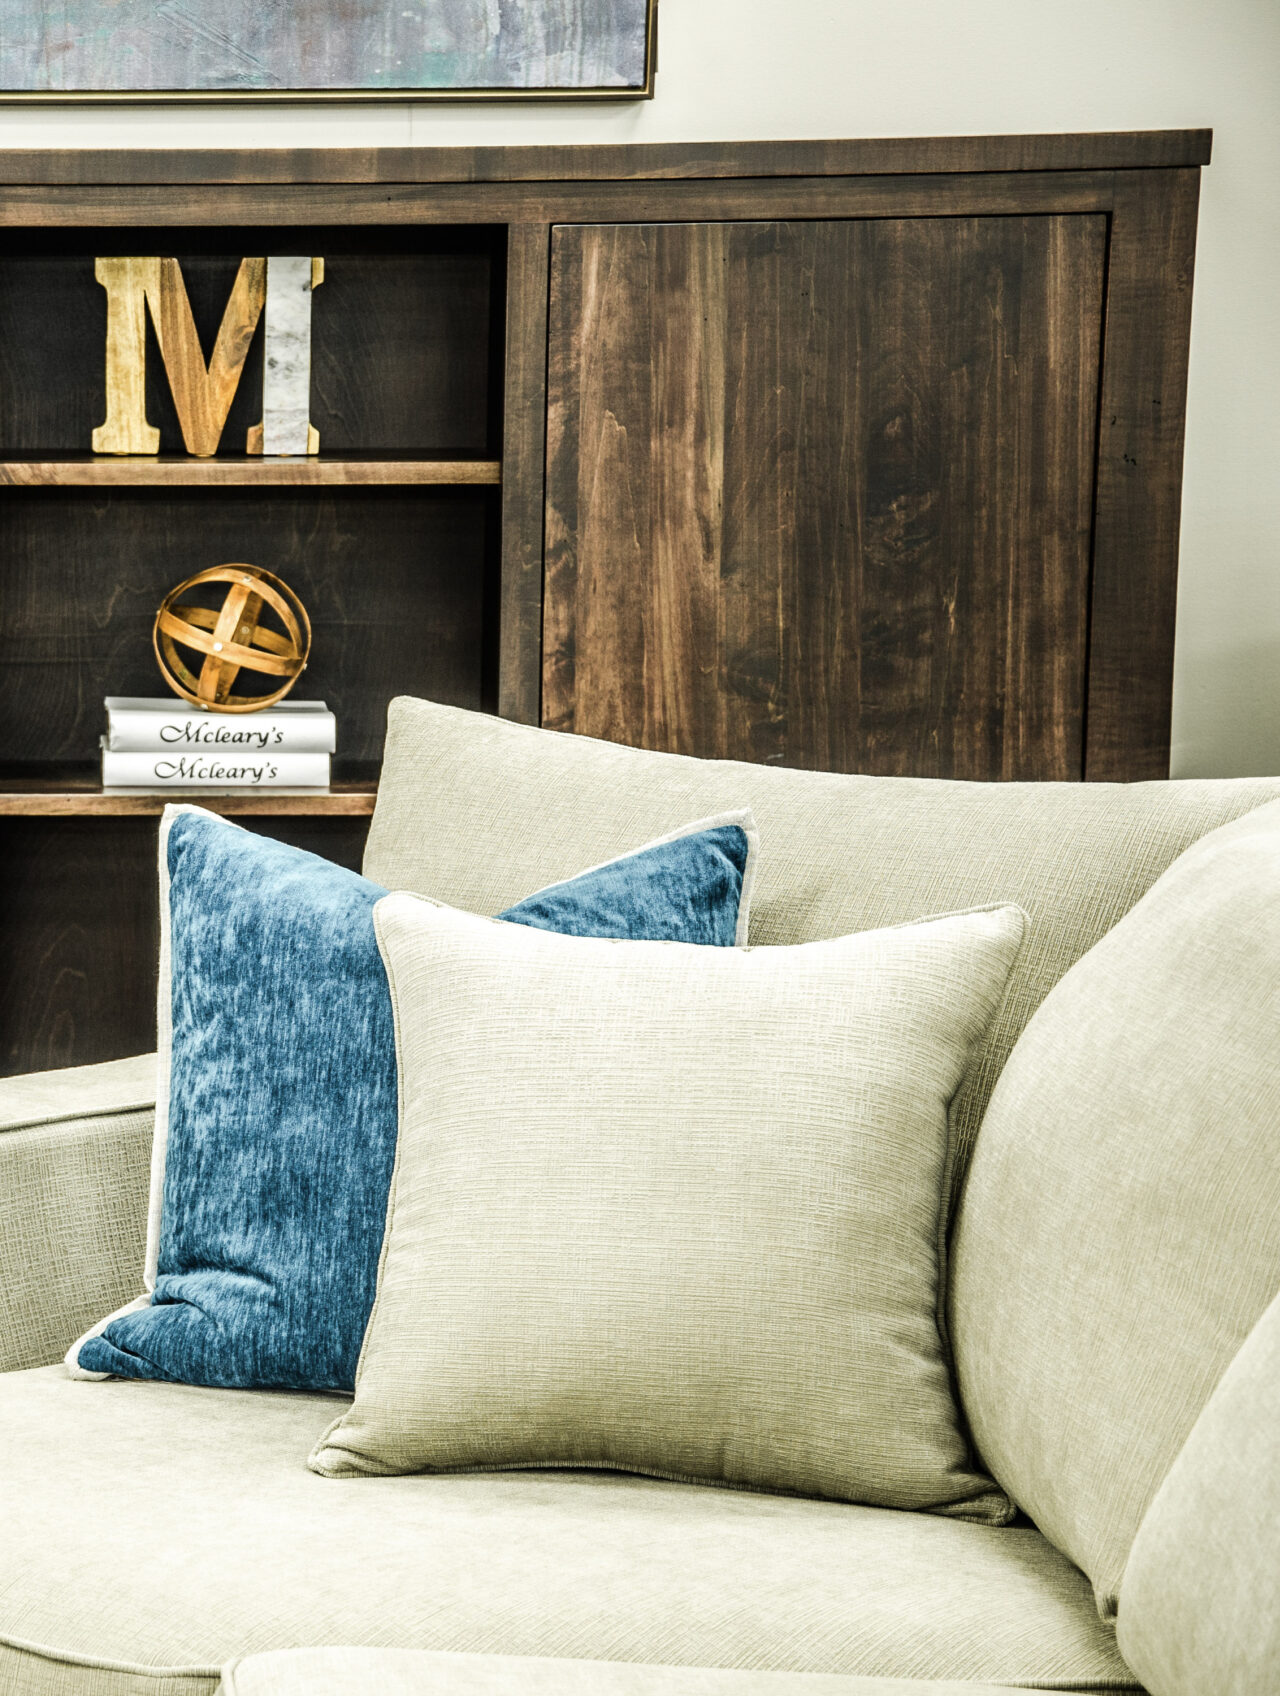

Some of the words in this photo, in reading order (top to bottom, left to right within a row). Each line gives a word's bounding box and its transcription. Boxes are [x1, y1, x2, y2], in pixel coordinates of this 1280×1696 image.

[91, 256, 325, 457] M
[160, 721, 284, 748] Mcleary's
[154, 757, 278, 783] Mcleary's
